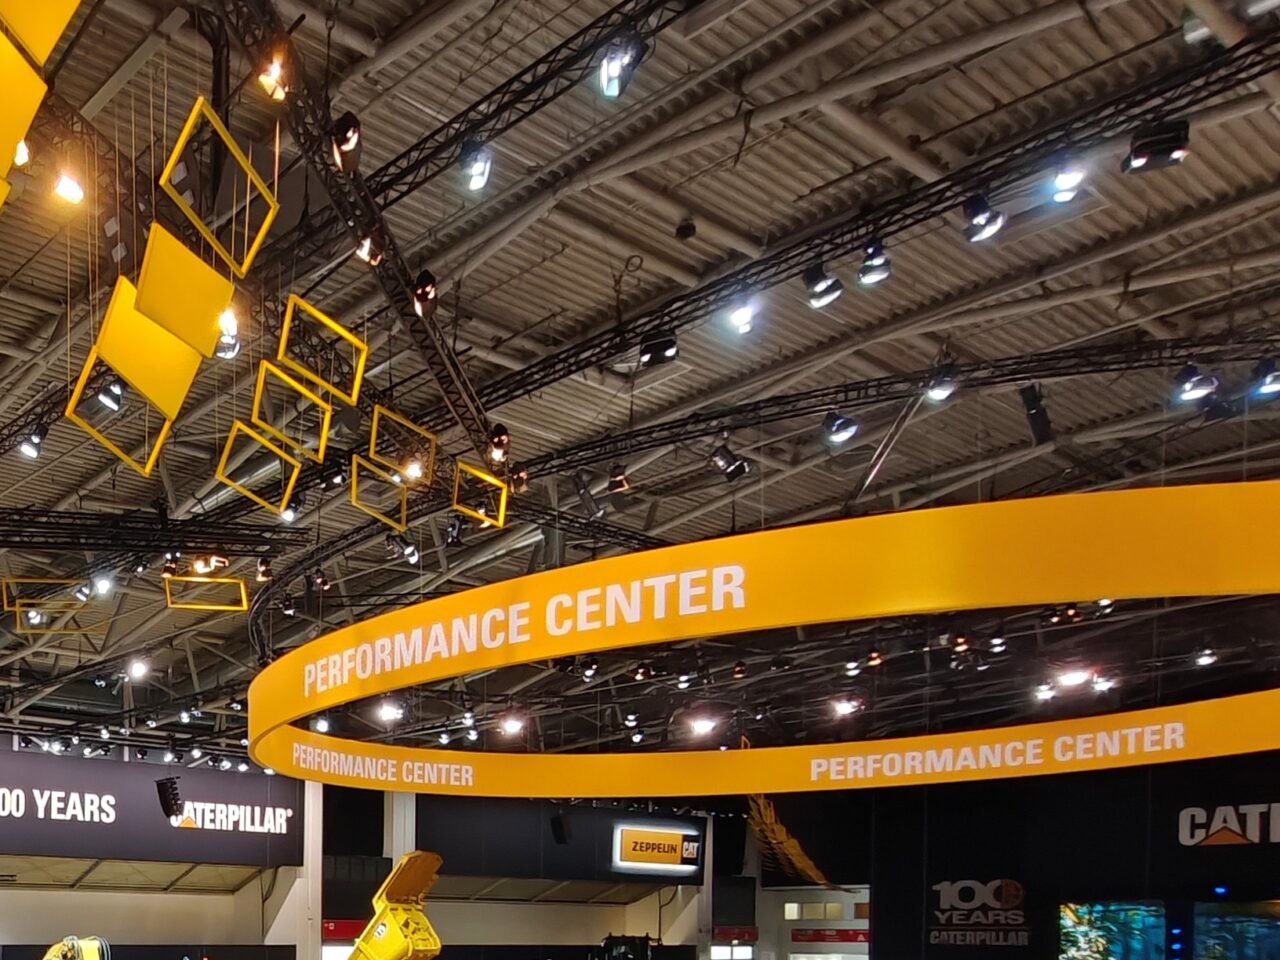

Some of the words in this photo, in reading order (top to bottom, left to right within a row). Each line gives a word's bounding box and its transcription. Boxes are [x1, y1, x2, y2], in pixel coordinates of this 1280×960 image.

[303, 602, 531, 698] PERFORMANCE
[545, 564, 746, 637] CENTER
[292, 743, 397, 781] PERFORMANCE
[402, 761, 474, 786] CENTER
[809, 739, 1044, 781] PERFORMANCE
[1053, 722, 1185, 761] CENTER
[32, 789, 116, 823] YEARS
[632, 841, 678, 854] ZEPPELIN
[683, 842, 700, 858] CAT
[932, 879, 1024, 910] 100
[933, 910, 1025, 925] YEARS
[929, 930, 1029, 946] CATERPILLAR
